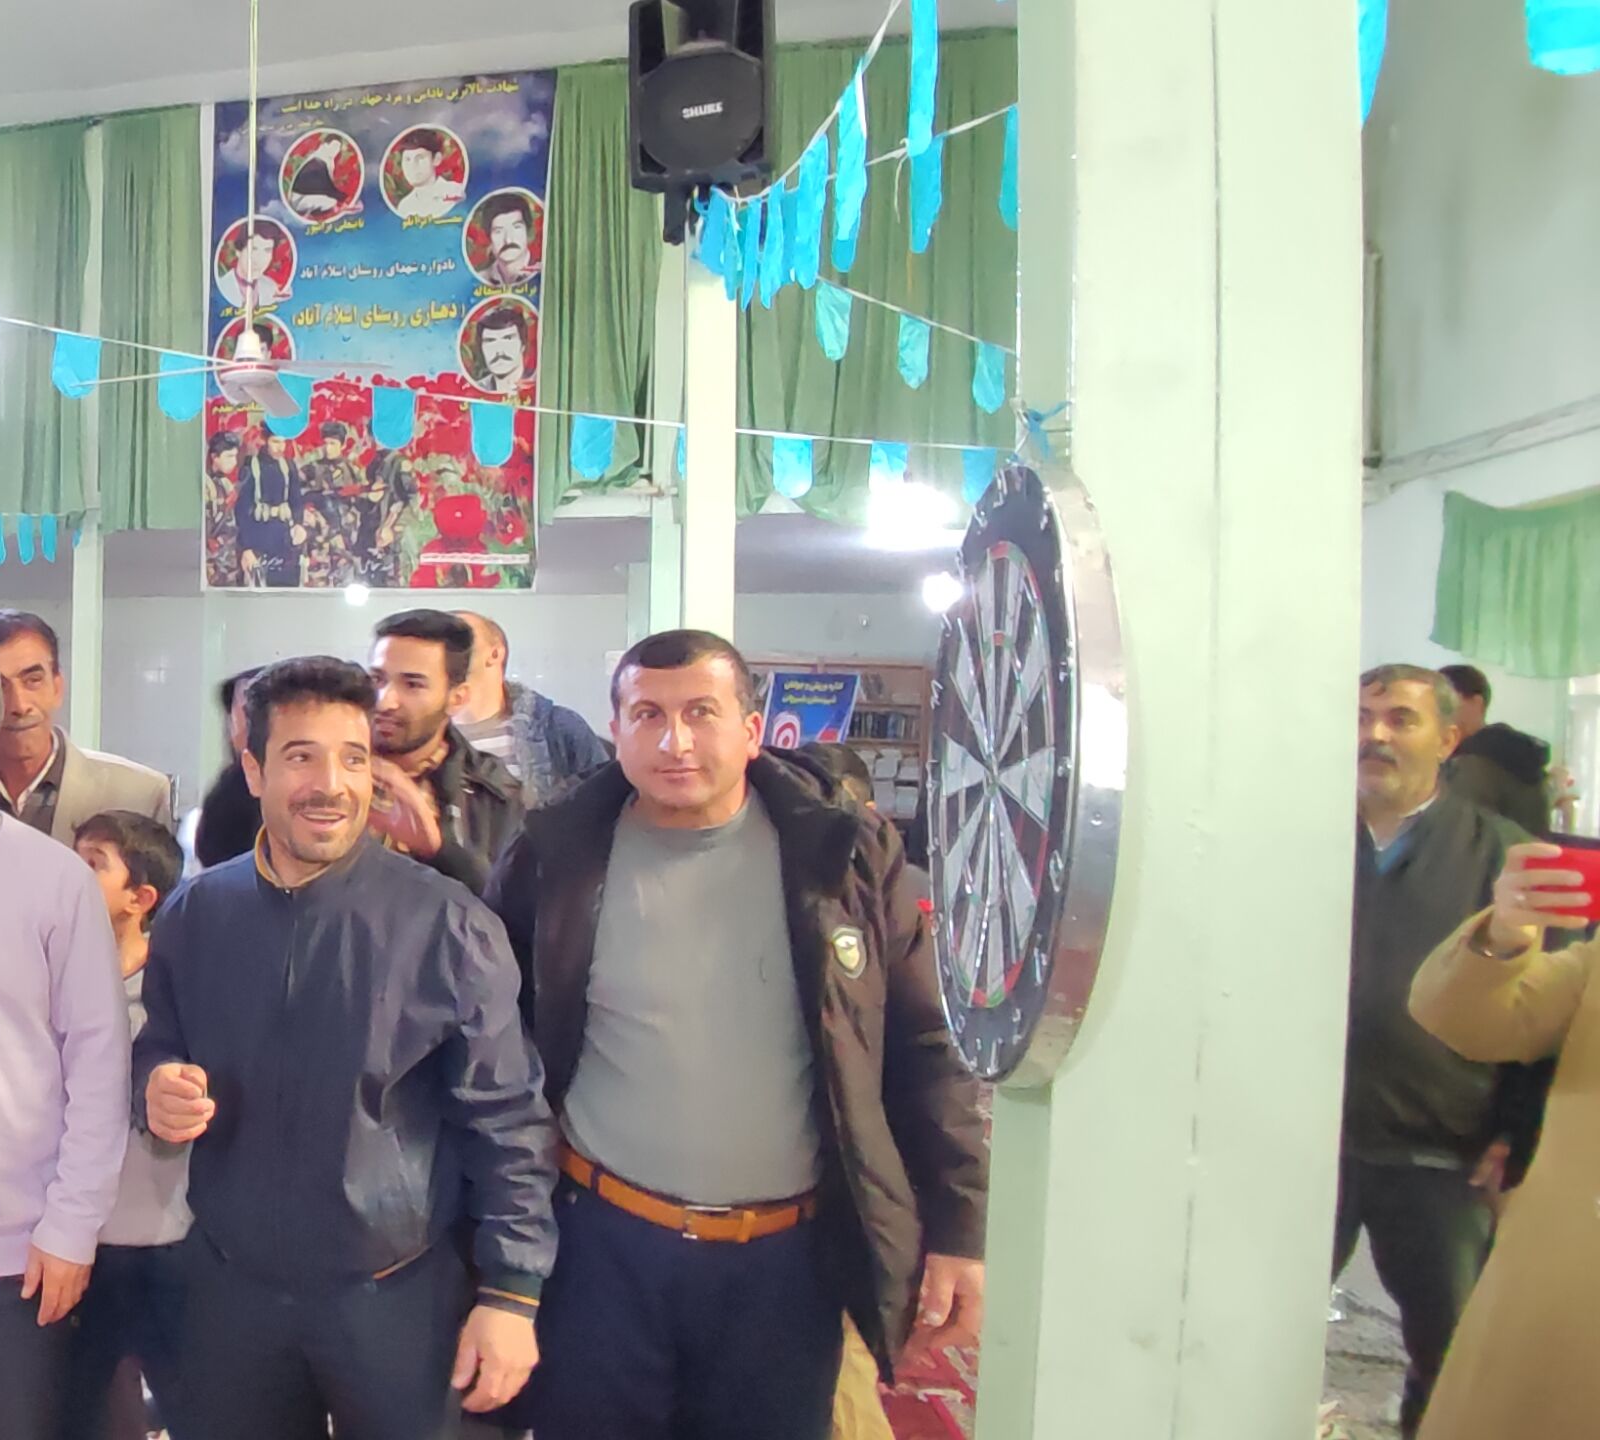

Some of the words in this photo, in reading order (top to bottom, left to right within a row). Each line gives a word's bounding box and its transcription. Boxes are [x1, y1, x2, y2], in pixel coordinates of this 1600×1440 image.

[300, 264, 319, 279] آباد
[321, 264, 346, 280] اسلام
[348, 265, 383, 280] روستای
[386, 262, 419, 277] شهدای
[324, 304, 357, 331] اسلام
[359, 303, 406, 329] روستای
